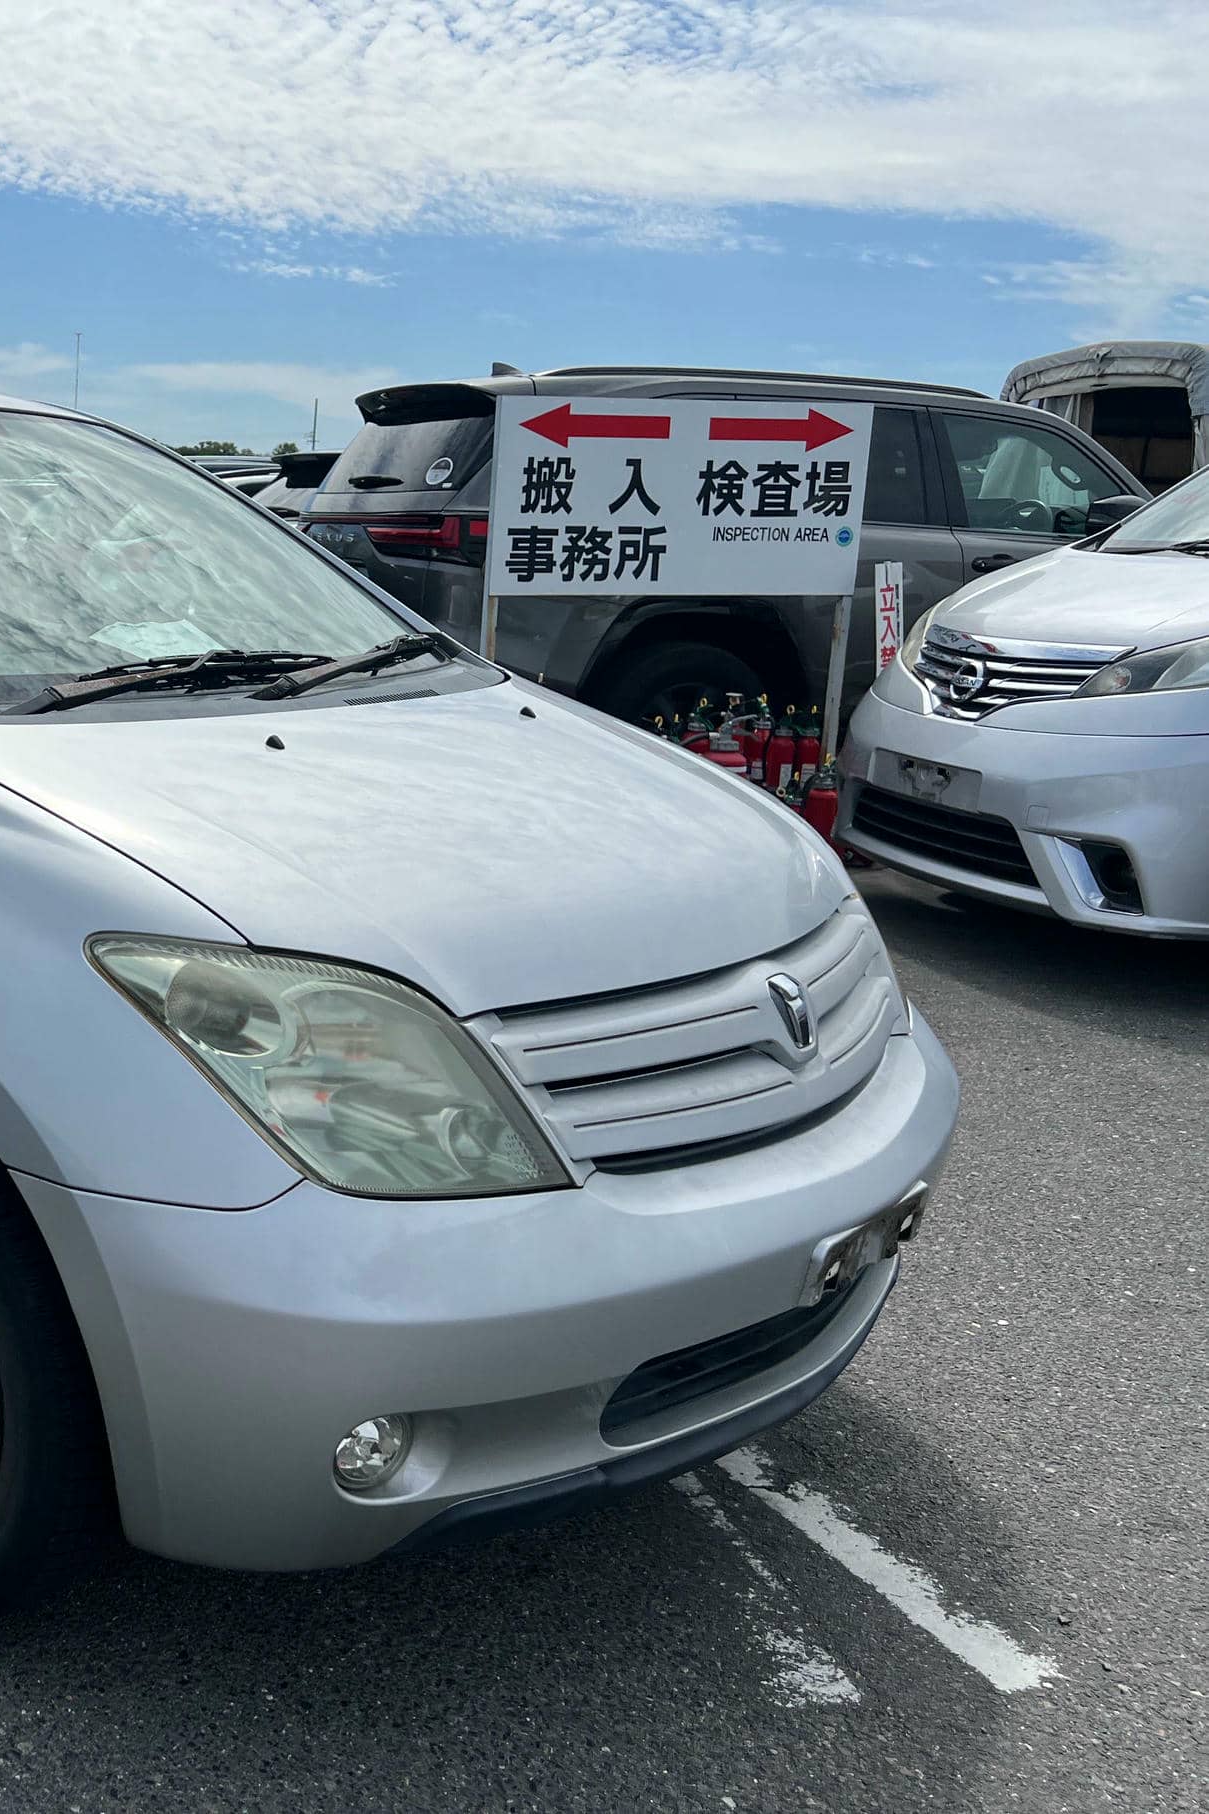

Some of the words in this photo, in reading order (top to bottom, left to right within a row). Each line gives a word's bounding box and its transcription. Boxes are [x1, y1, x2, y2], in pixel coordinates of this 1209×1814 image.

[521, 457, 661, 516] 搬入
[696, 460, 852, 517] 検査場
[505, 526, 666, 582] 事務所
[713, 527, 789, 541] INSPECTION
[794, 528, 828, 542] AREA
